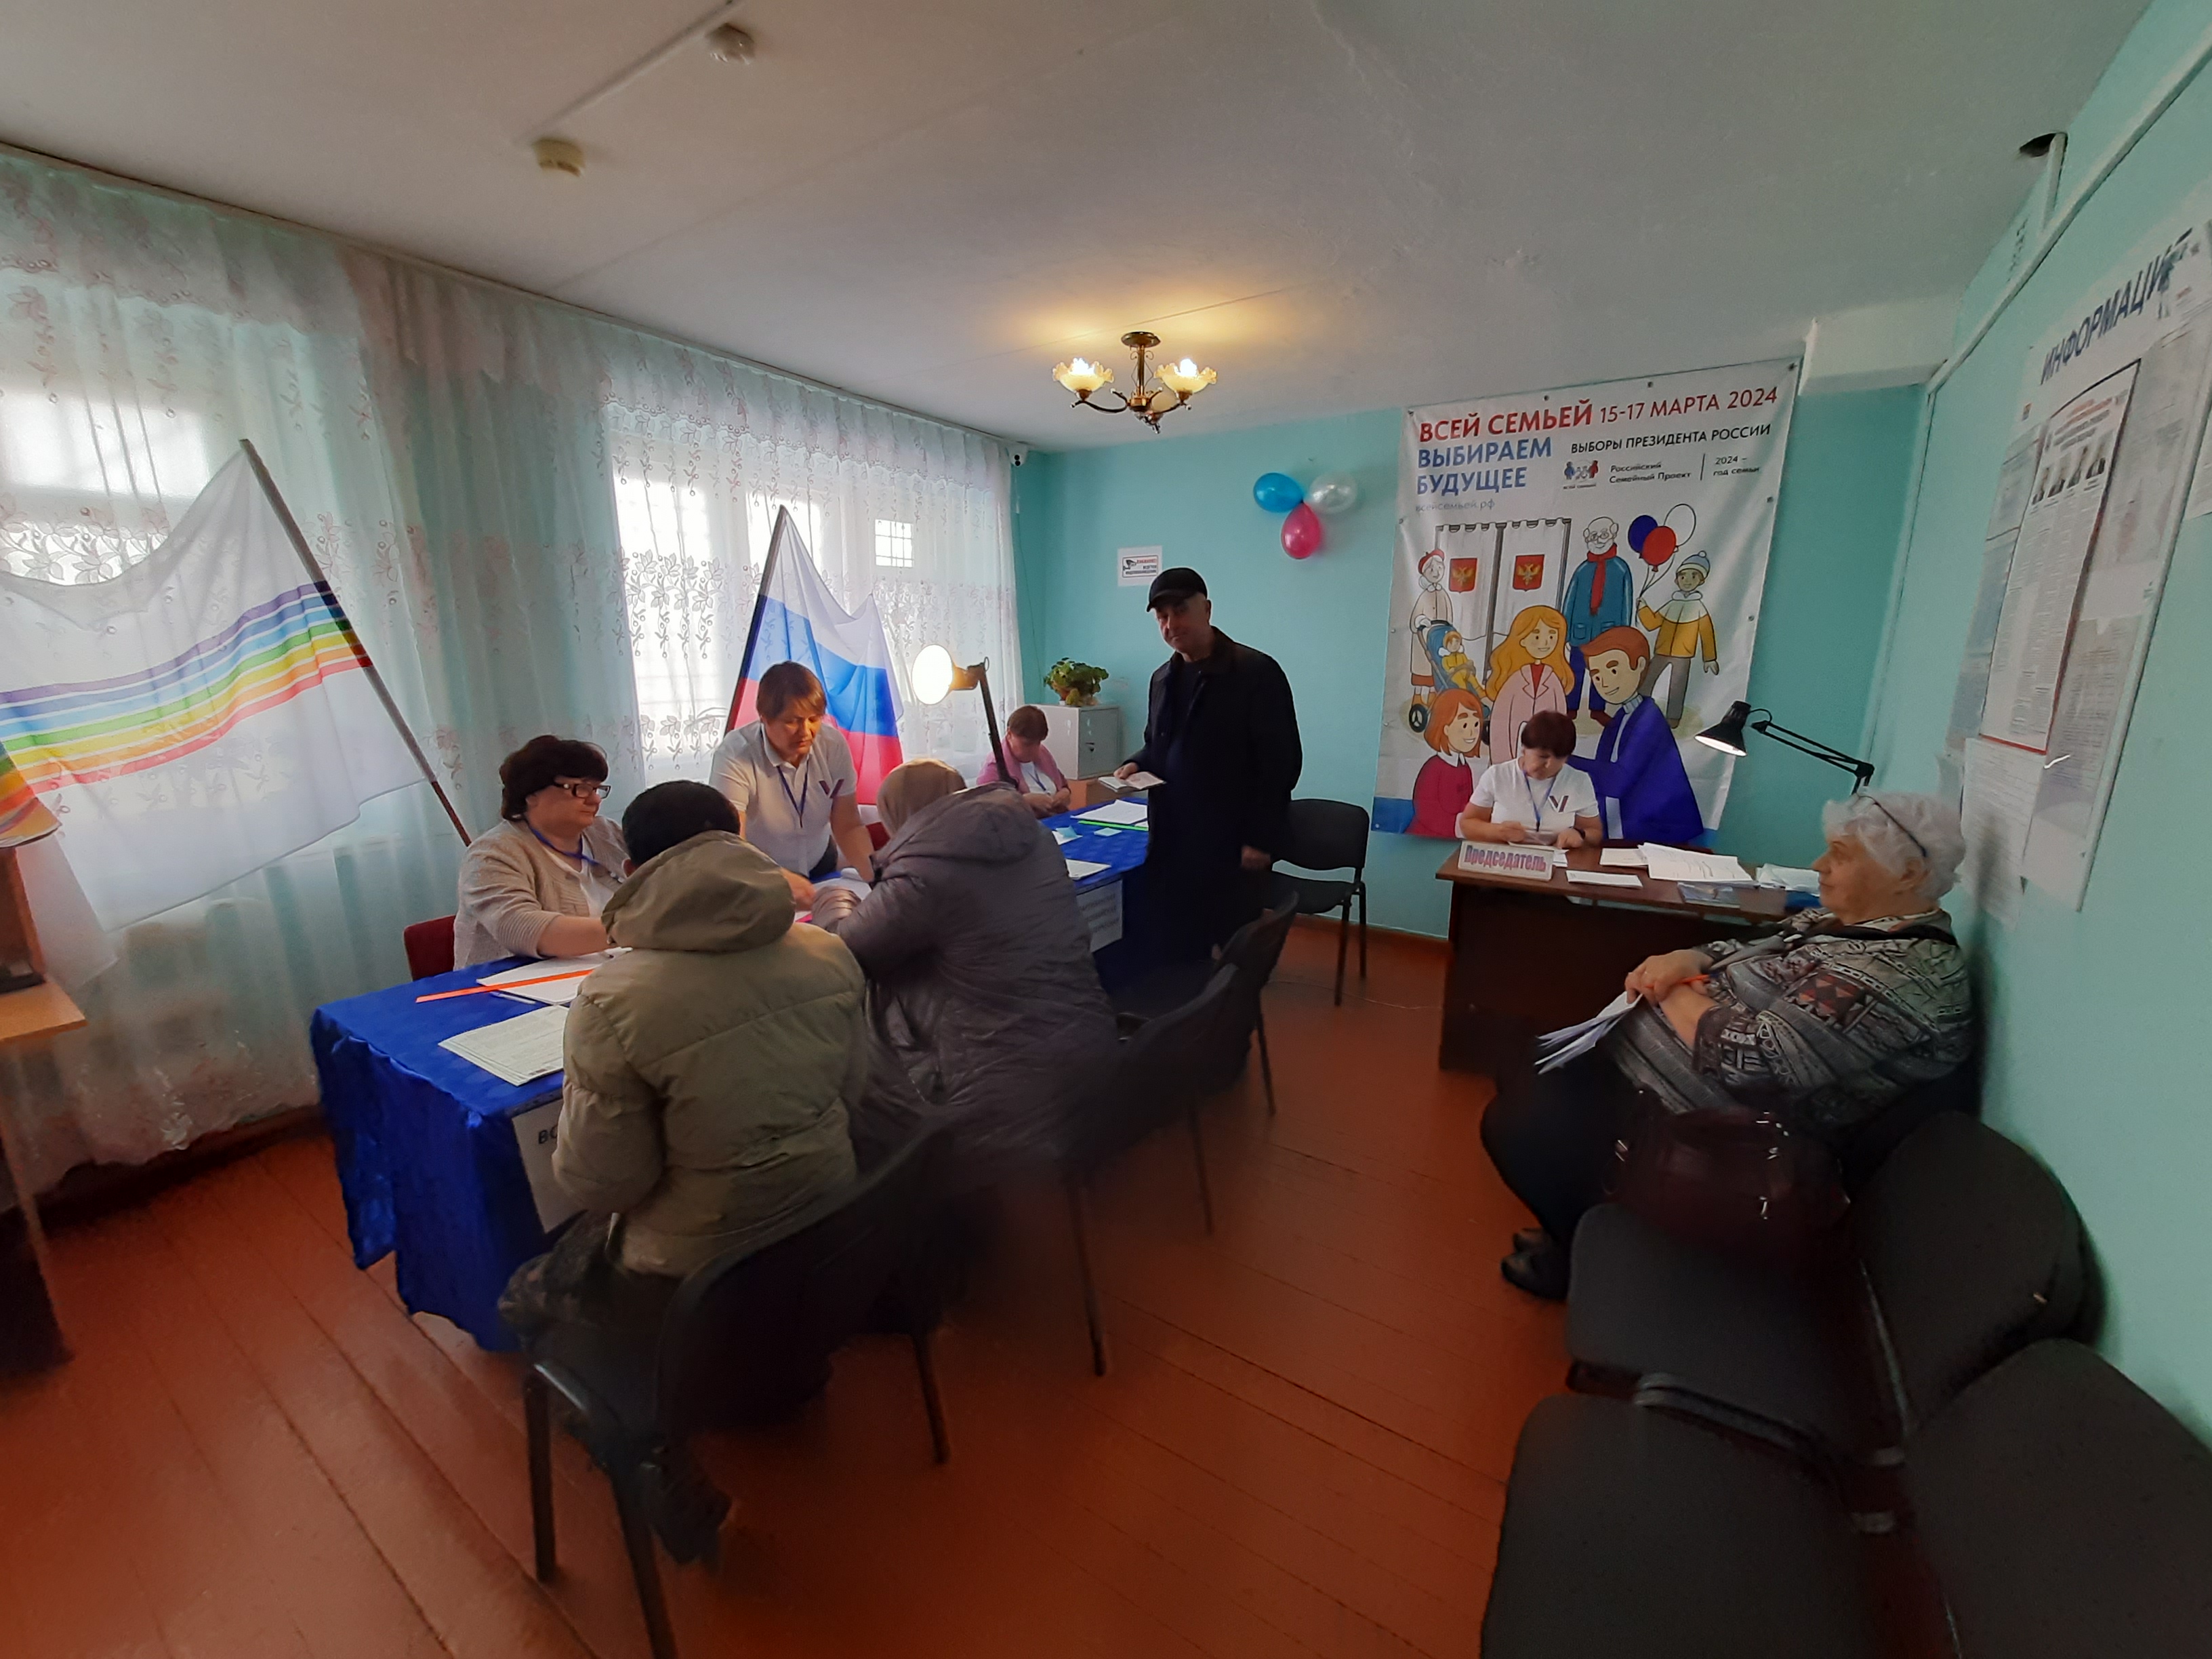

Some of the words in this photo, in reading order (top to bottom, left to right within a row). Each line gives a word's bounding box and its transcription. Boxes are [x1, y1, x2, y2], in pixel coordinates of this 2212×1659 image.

[1600, 403, 1645, 424] 15-17
[1650, 394, 1720, 418] МАРТА
[1727, 386, 1778, 409] 2024
[1419, 413, 1480, 443] ВСЕЙ
[1488, 398, 1593, 435] СЕМЬЕЙ
[1418, 436, 1552, 469] ВЫБИРАЕМ
[1571, 438, 1622, 453] ВЫБОРЫ
[1626, 431, 1707, 449] ПРЕЗИДЕНТА
[1711, 424, 1771, 441] РОССИИ
[1715, 455, 1739, 466] 2024
[1417, 467, 1528, 497] БУДУЩЕЕ
[1464, 844, 1547, 873] Председатель
